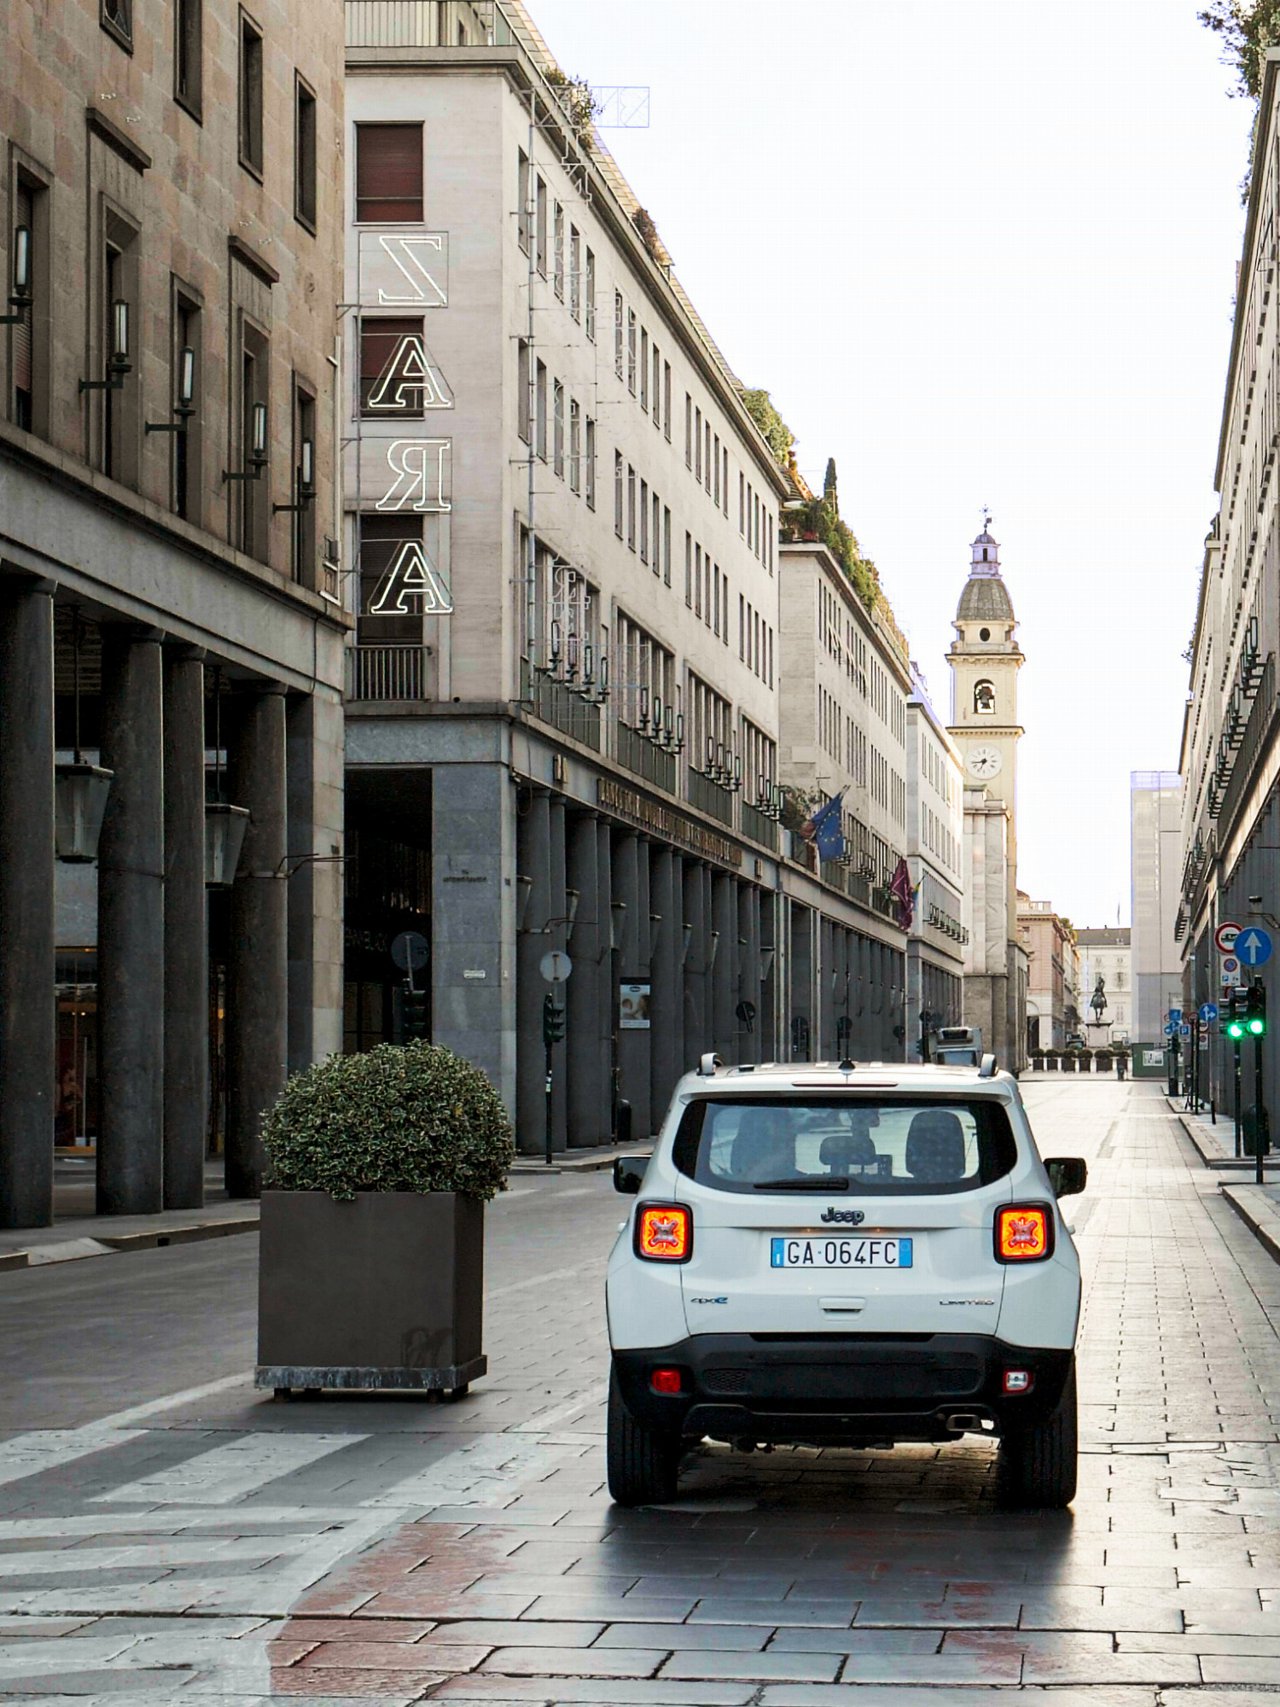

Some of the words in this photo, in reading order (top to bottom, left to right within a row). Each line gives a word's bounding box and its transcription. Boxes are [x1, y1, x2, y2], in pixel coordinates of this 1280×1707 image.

[821, 1207, 865, 1226] Jeep
[788, 1241, 814, 1264] GA
[825, 1241, 896, 1264] 064FC
